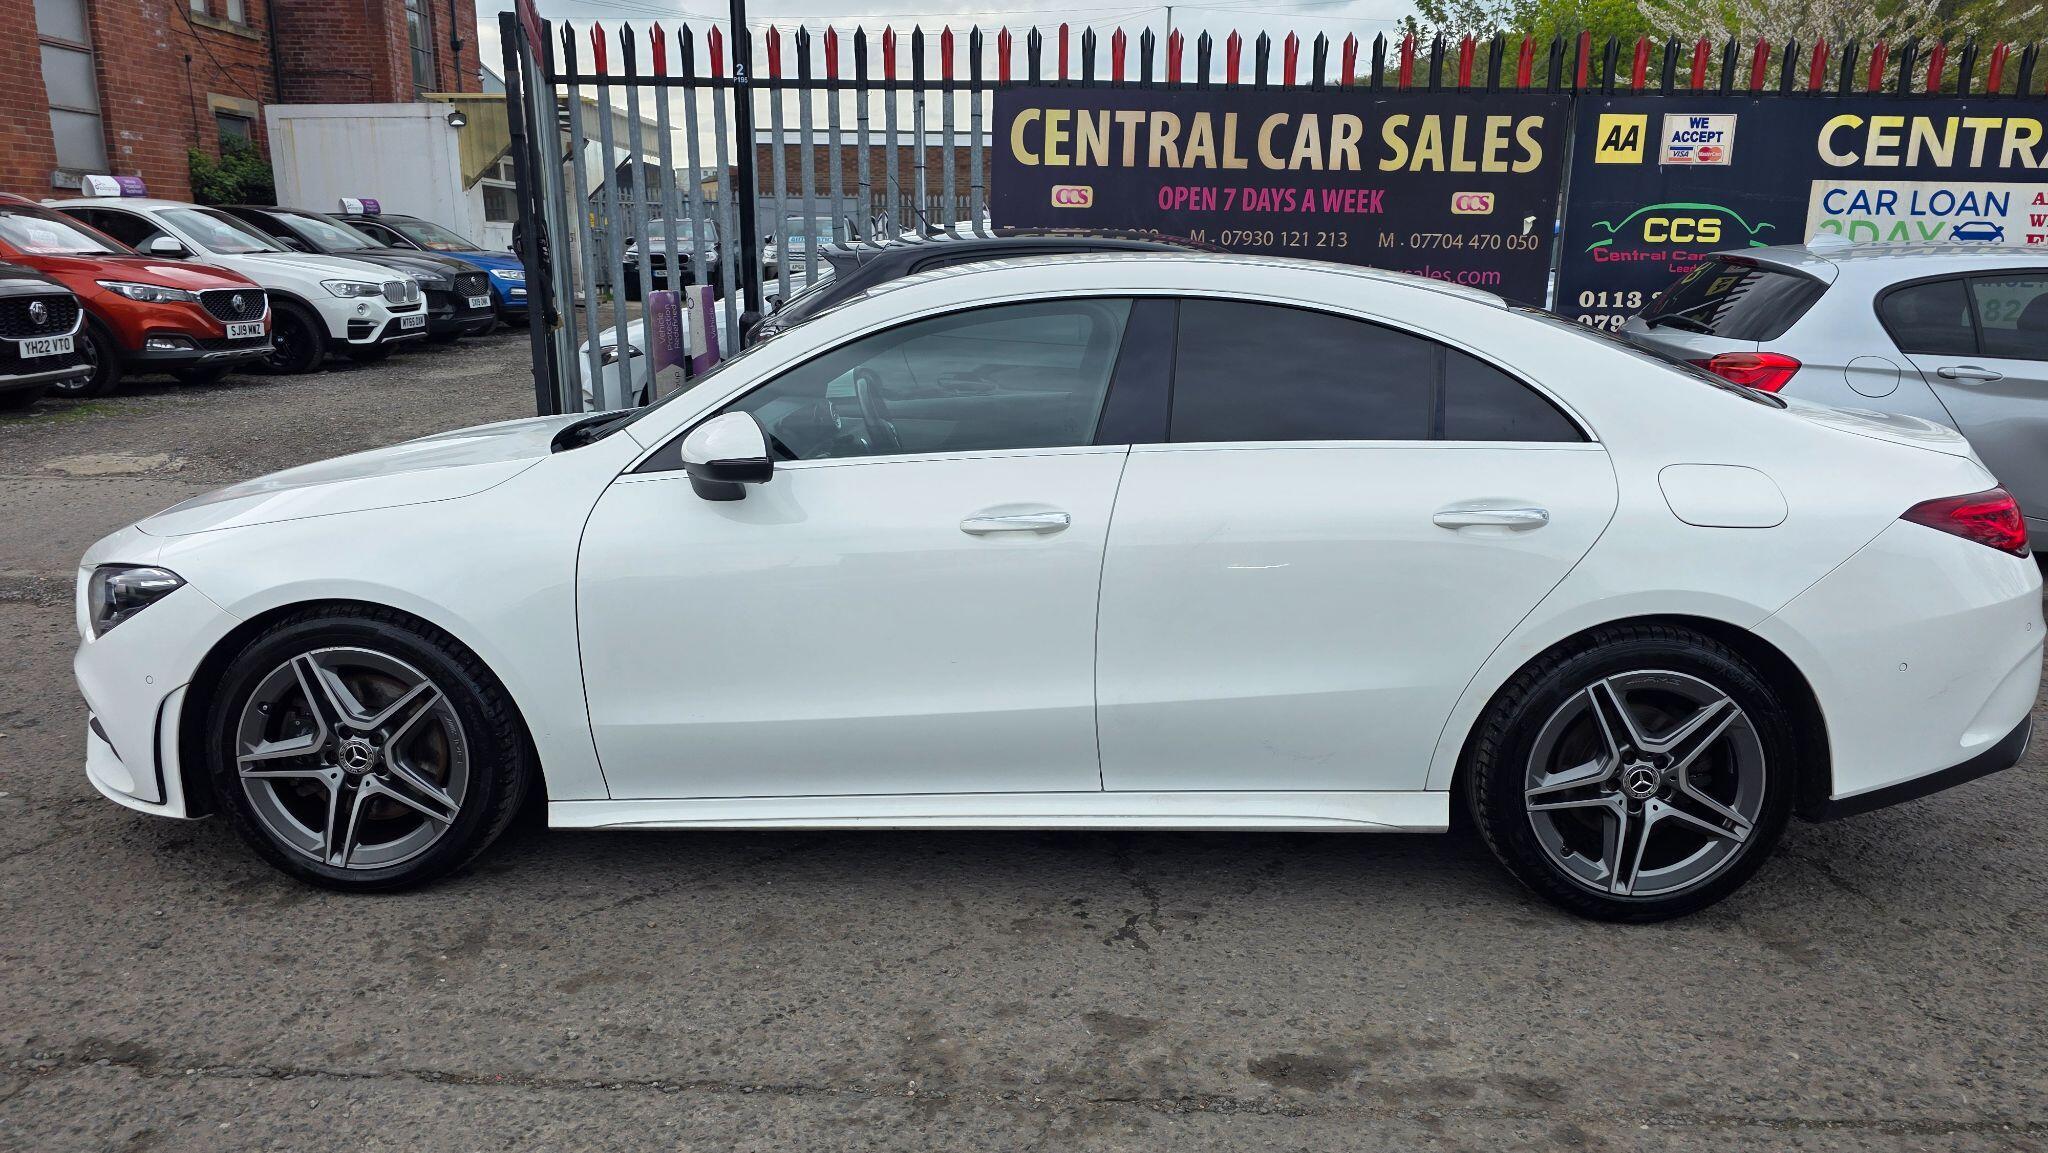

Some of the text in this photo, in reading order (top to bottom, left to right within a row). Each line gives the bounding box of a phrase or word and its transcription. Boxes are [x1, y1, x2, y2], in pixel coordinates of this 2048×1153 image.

[736, 63, 744, 76] 2
[1689, 116, 1710, 129] WE
[1010, 107, 1545, 174] CENTRAL CAR SALES
[1601, 124, 1640, 152] AA
[1671, 130, 1724, 143] ACCEPT
[1817, 114, 2048, 169] CENTR
[1672, 150, 1690, 158] VISA
[1054, 188, 1089, 205] CCS
[1158, 185, 1385, 214] OPEN 7 DAYS A WEEK
[1455, 194, 1490, 212] CCS
[1822, 188, 2011, 217] CAR LOAN
[1221, 229, 1274, 246] 07930
[1281, 231, 1309, 247] 121
[1315, 232, 1348, 248] 213
[1643, 217, 1722, 244] CCS
[1378, 232, 1394, 248] M
[1410, 232, 1464, 249] 07704
[1468, 234, 1501, 250] 470
[1506, 234, 1539, 250] 050
[1593, 248, 1666, 262] Central
[1578, 290, 1642, 309] 0113
[657, 312, 665, 344] Vehicle
[665, 303, 673, 351] Protection
[1577, 314, 1633, 333] 079
[24, 337, 71, 354] YH22 VTO
